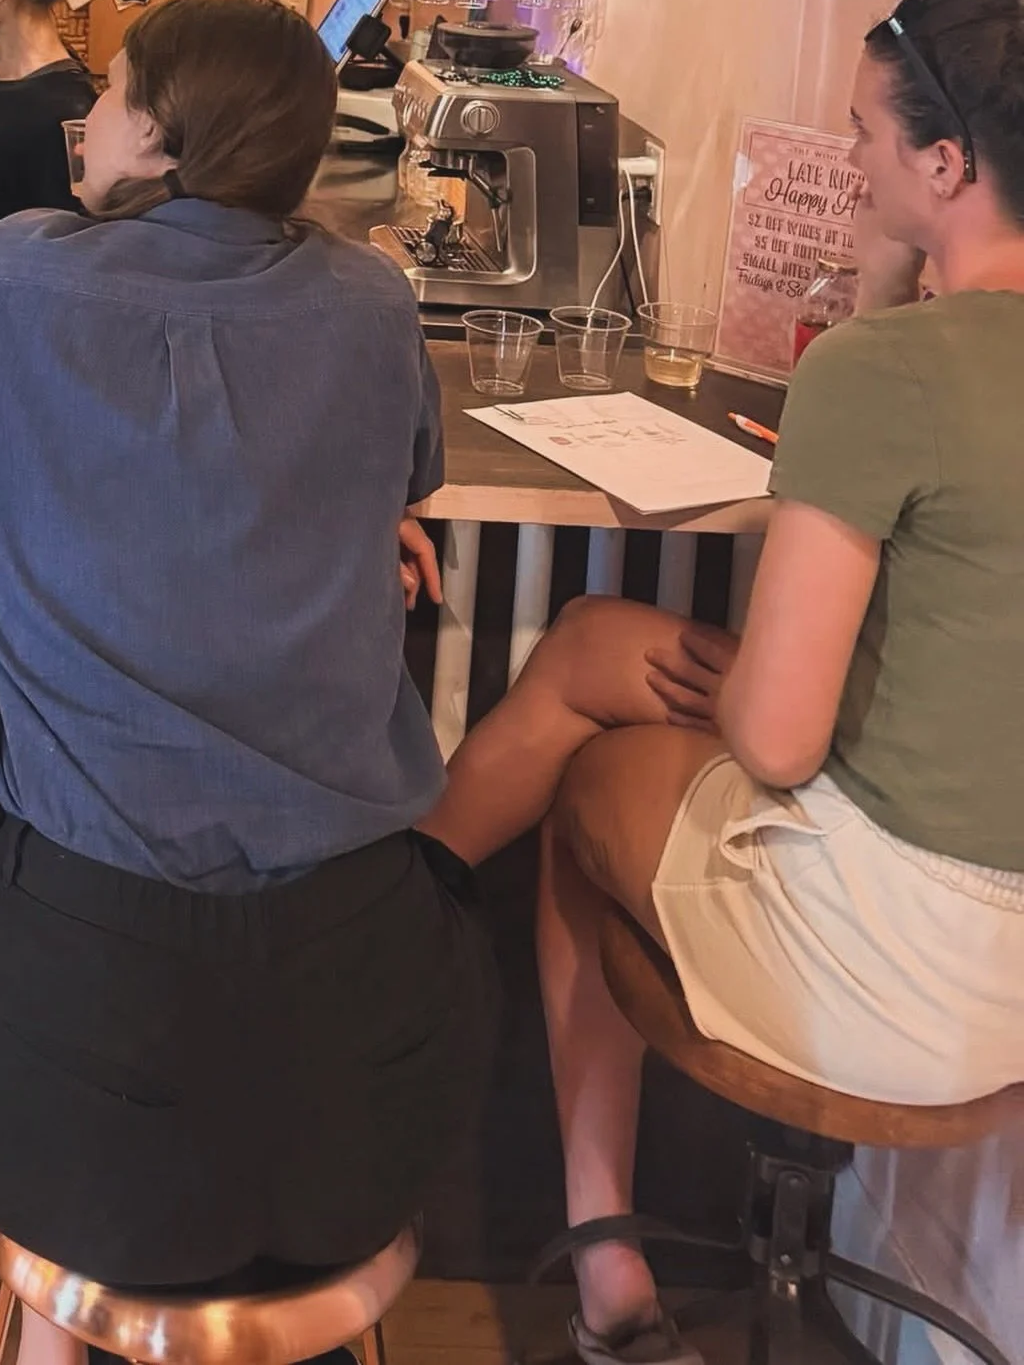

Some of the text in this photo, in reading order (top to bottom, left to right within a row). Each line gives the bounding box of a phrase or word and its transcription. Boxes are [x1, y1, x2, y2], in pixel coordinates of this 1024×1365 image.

[787, 159, 824, 186] LATE
[764, 177, 828, 216] Happy
[764, 215, 784, 233] OFF
[787, 219, 822, 242] WINES
[771, 238, 790, 255] OFF
[742, 253, 812, 281] SMALL BITES
